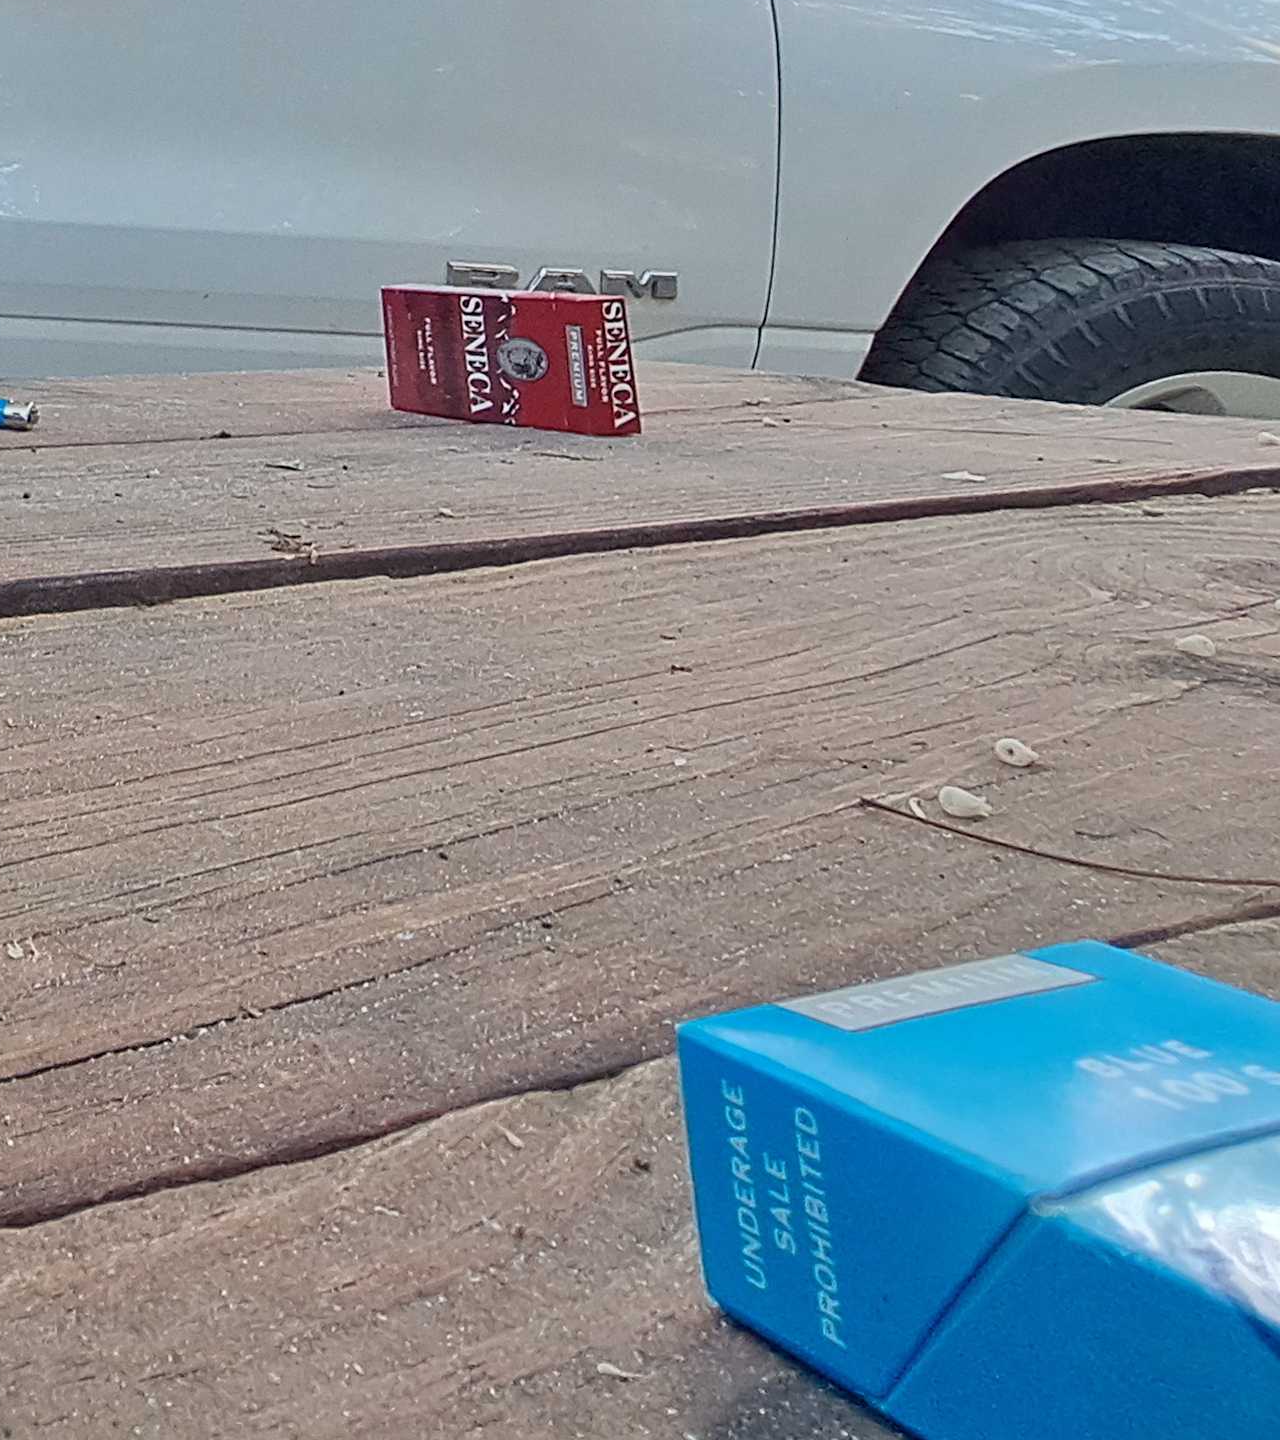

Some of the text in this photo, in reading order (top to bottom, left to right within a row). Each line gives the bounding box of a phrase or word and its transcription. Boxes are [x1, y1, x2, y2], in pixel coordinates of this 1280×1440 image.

[447, 260, 677, 299] RAM
[460, 295, 493, 413] SENECA
[569, 327, 585, 401] PREMIUM
[602, 302, 637, 429] SENECA
[721, 1078, 767, 1289] UNDERAGE
[764, 1151, 796, 1256] SALE
[795, 1106, 847, 1348] PROHIBITED
